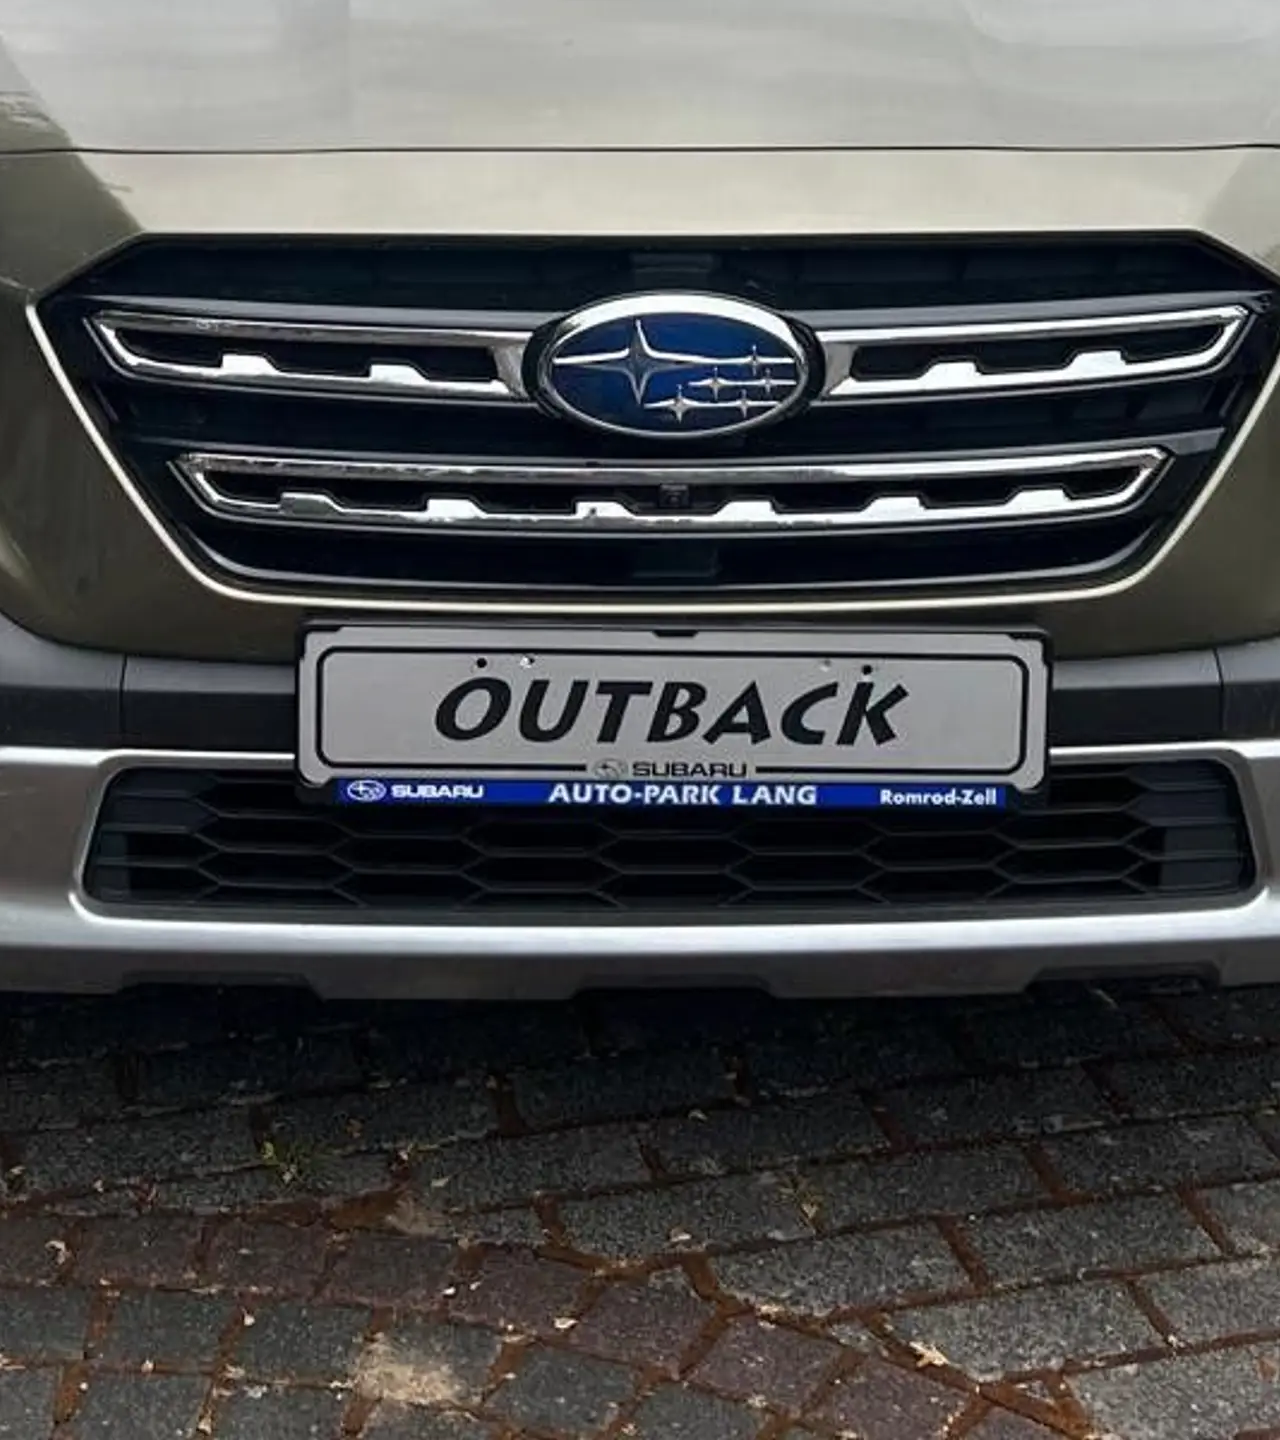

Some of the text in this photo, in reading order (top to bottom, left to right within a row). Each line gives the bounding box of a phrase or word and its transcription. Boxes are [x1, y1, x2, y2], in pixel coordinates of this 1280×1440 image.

[435, 676, 910, 747] OUTBACK
[632, 762, 748, 779] SUBARU
[391, 784, 485, 799] SUBARU
[548, 782, 818, 806] AUTO-PARK LANG
[880, 788, 997, 806] Romrod-Zell
